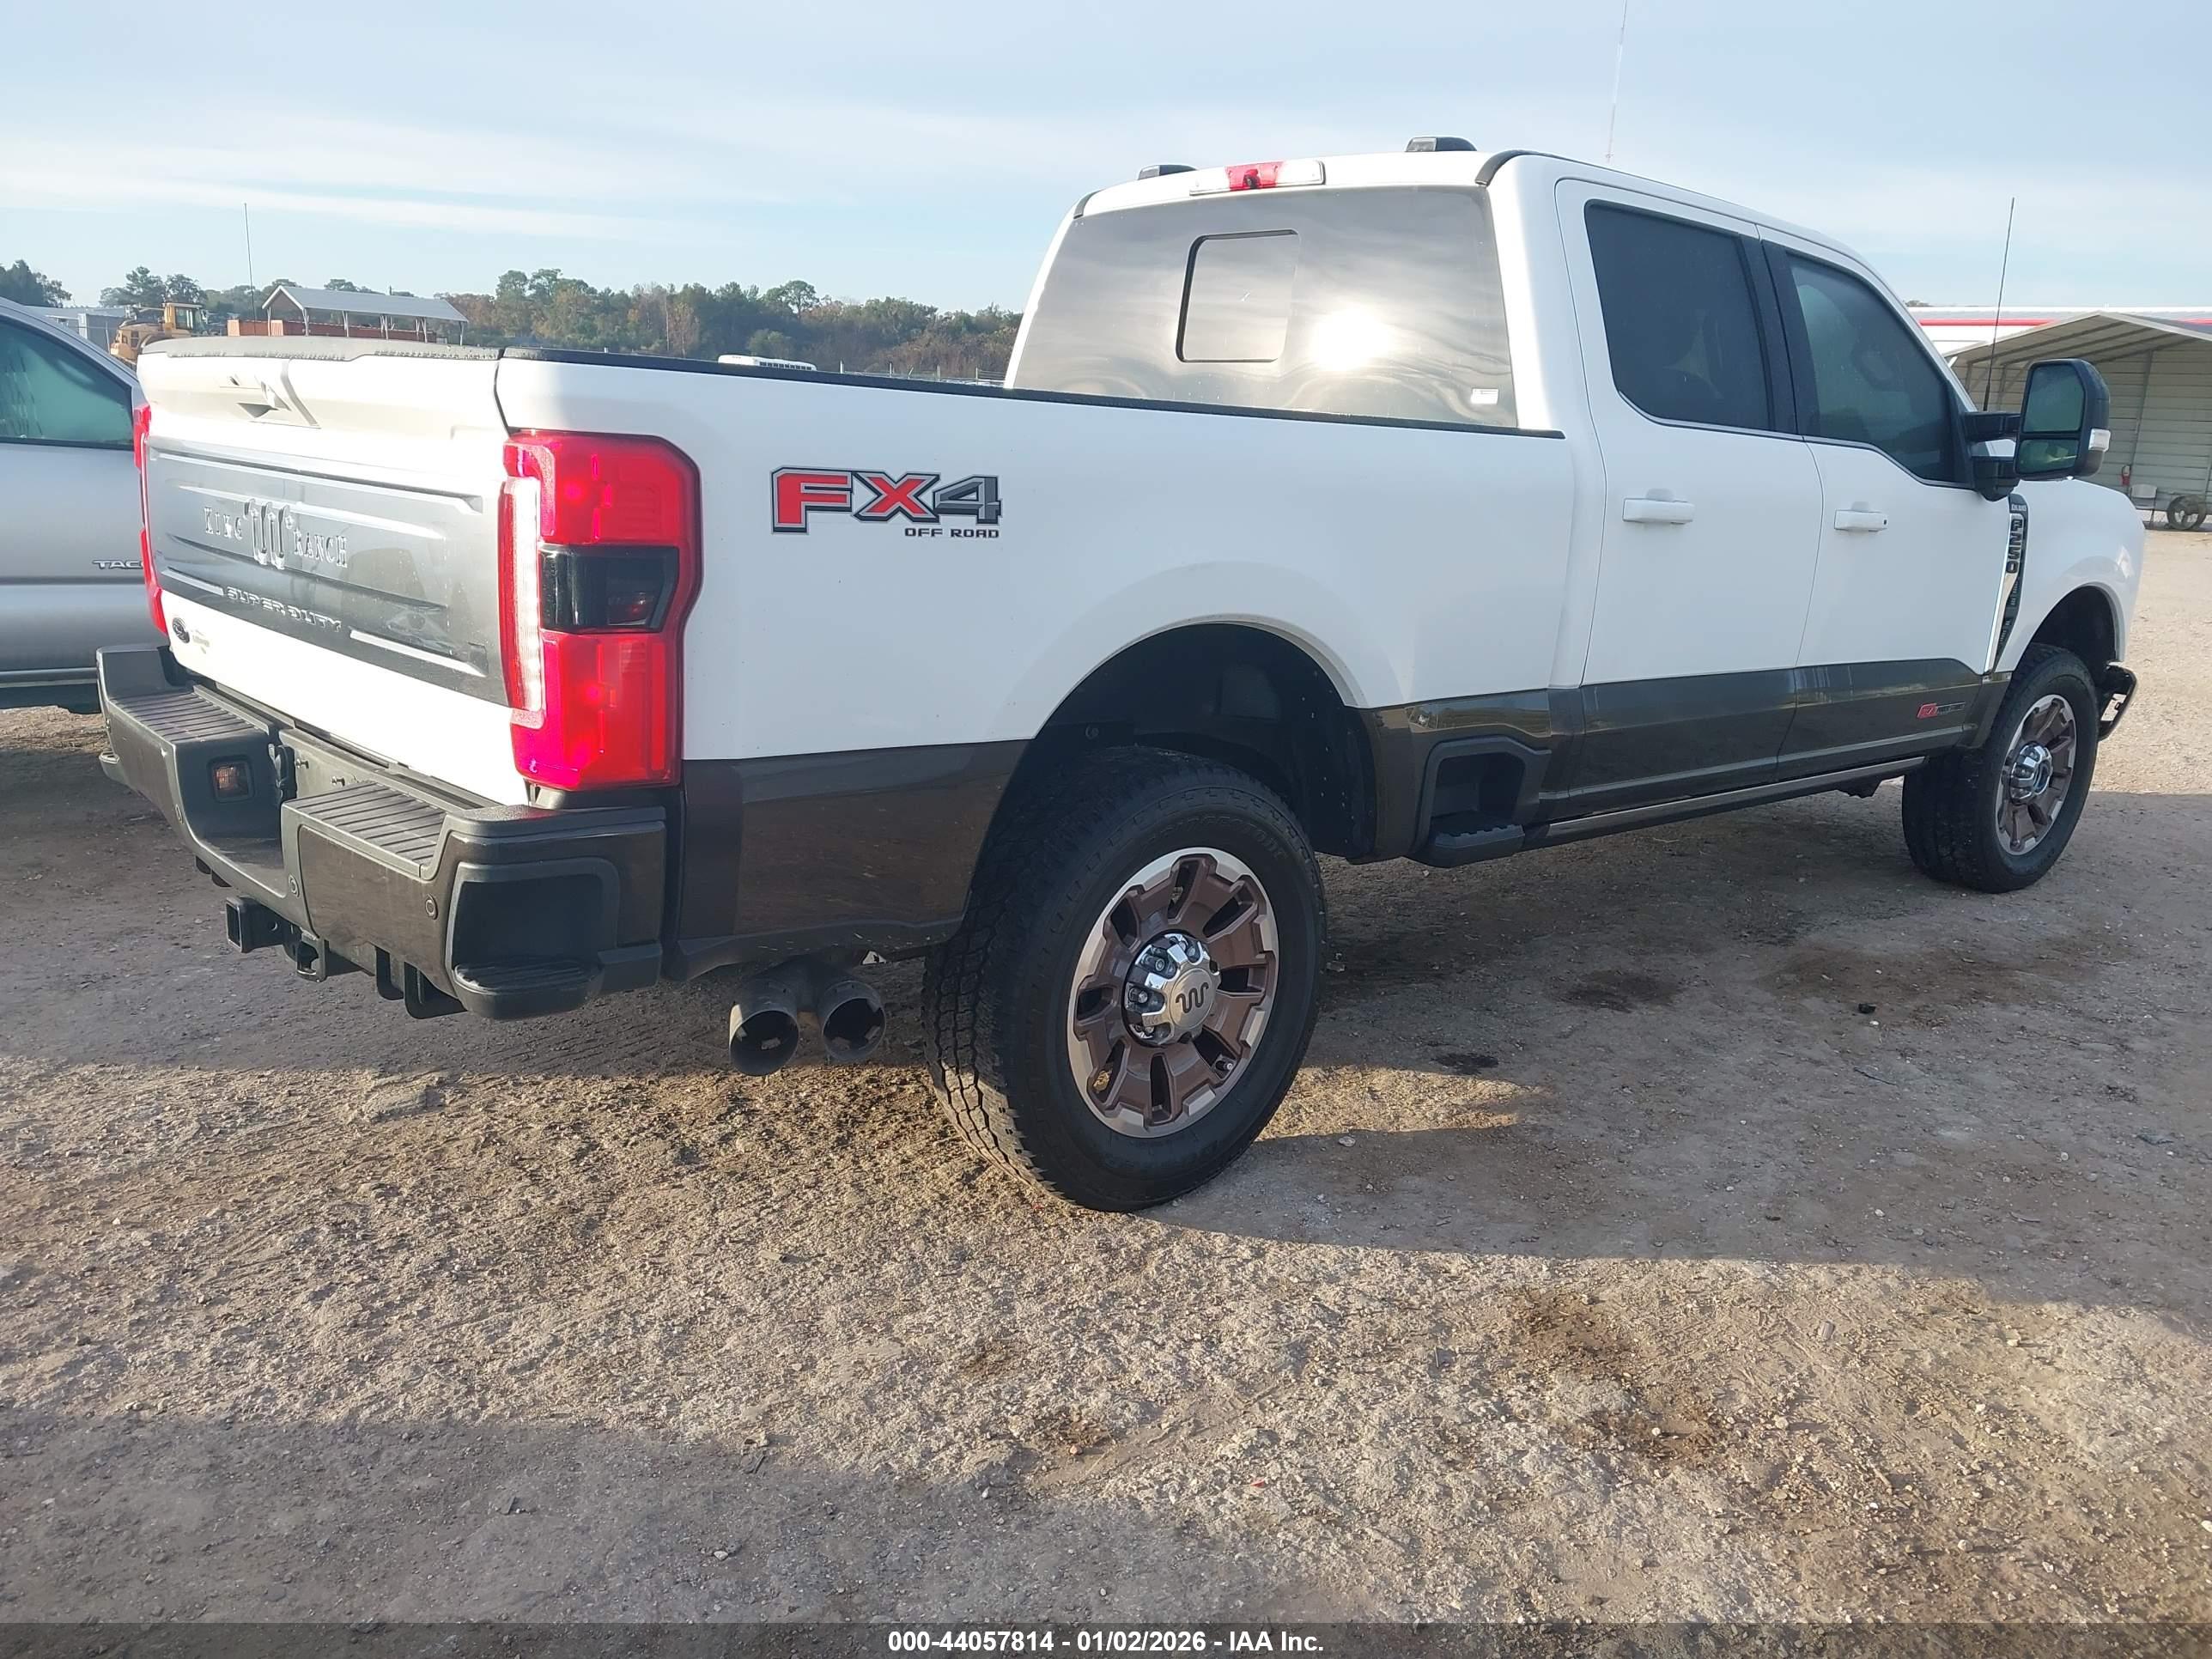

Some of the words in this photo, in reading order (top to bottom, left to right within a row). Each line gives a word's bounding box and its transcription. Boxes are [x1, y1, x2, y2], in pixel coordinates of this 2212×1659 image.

[771, 466, 1001, 534] FX4
[204, 507, 243, 541] KING
[293, 528, 348, 568] RANCH
[904, 527, 943, 538] OFF
[950, 528, 1000, 539] ROAD
[92, 560, 144, 569] TAC
[226, 586, 286, 616] SUPER
[287, 605, 342, 633] DUTY
